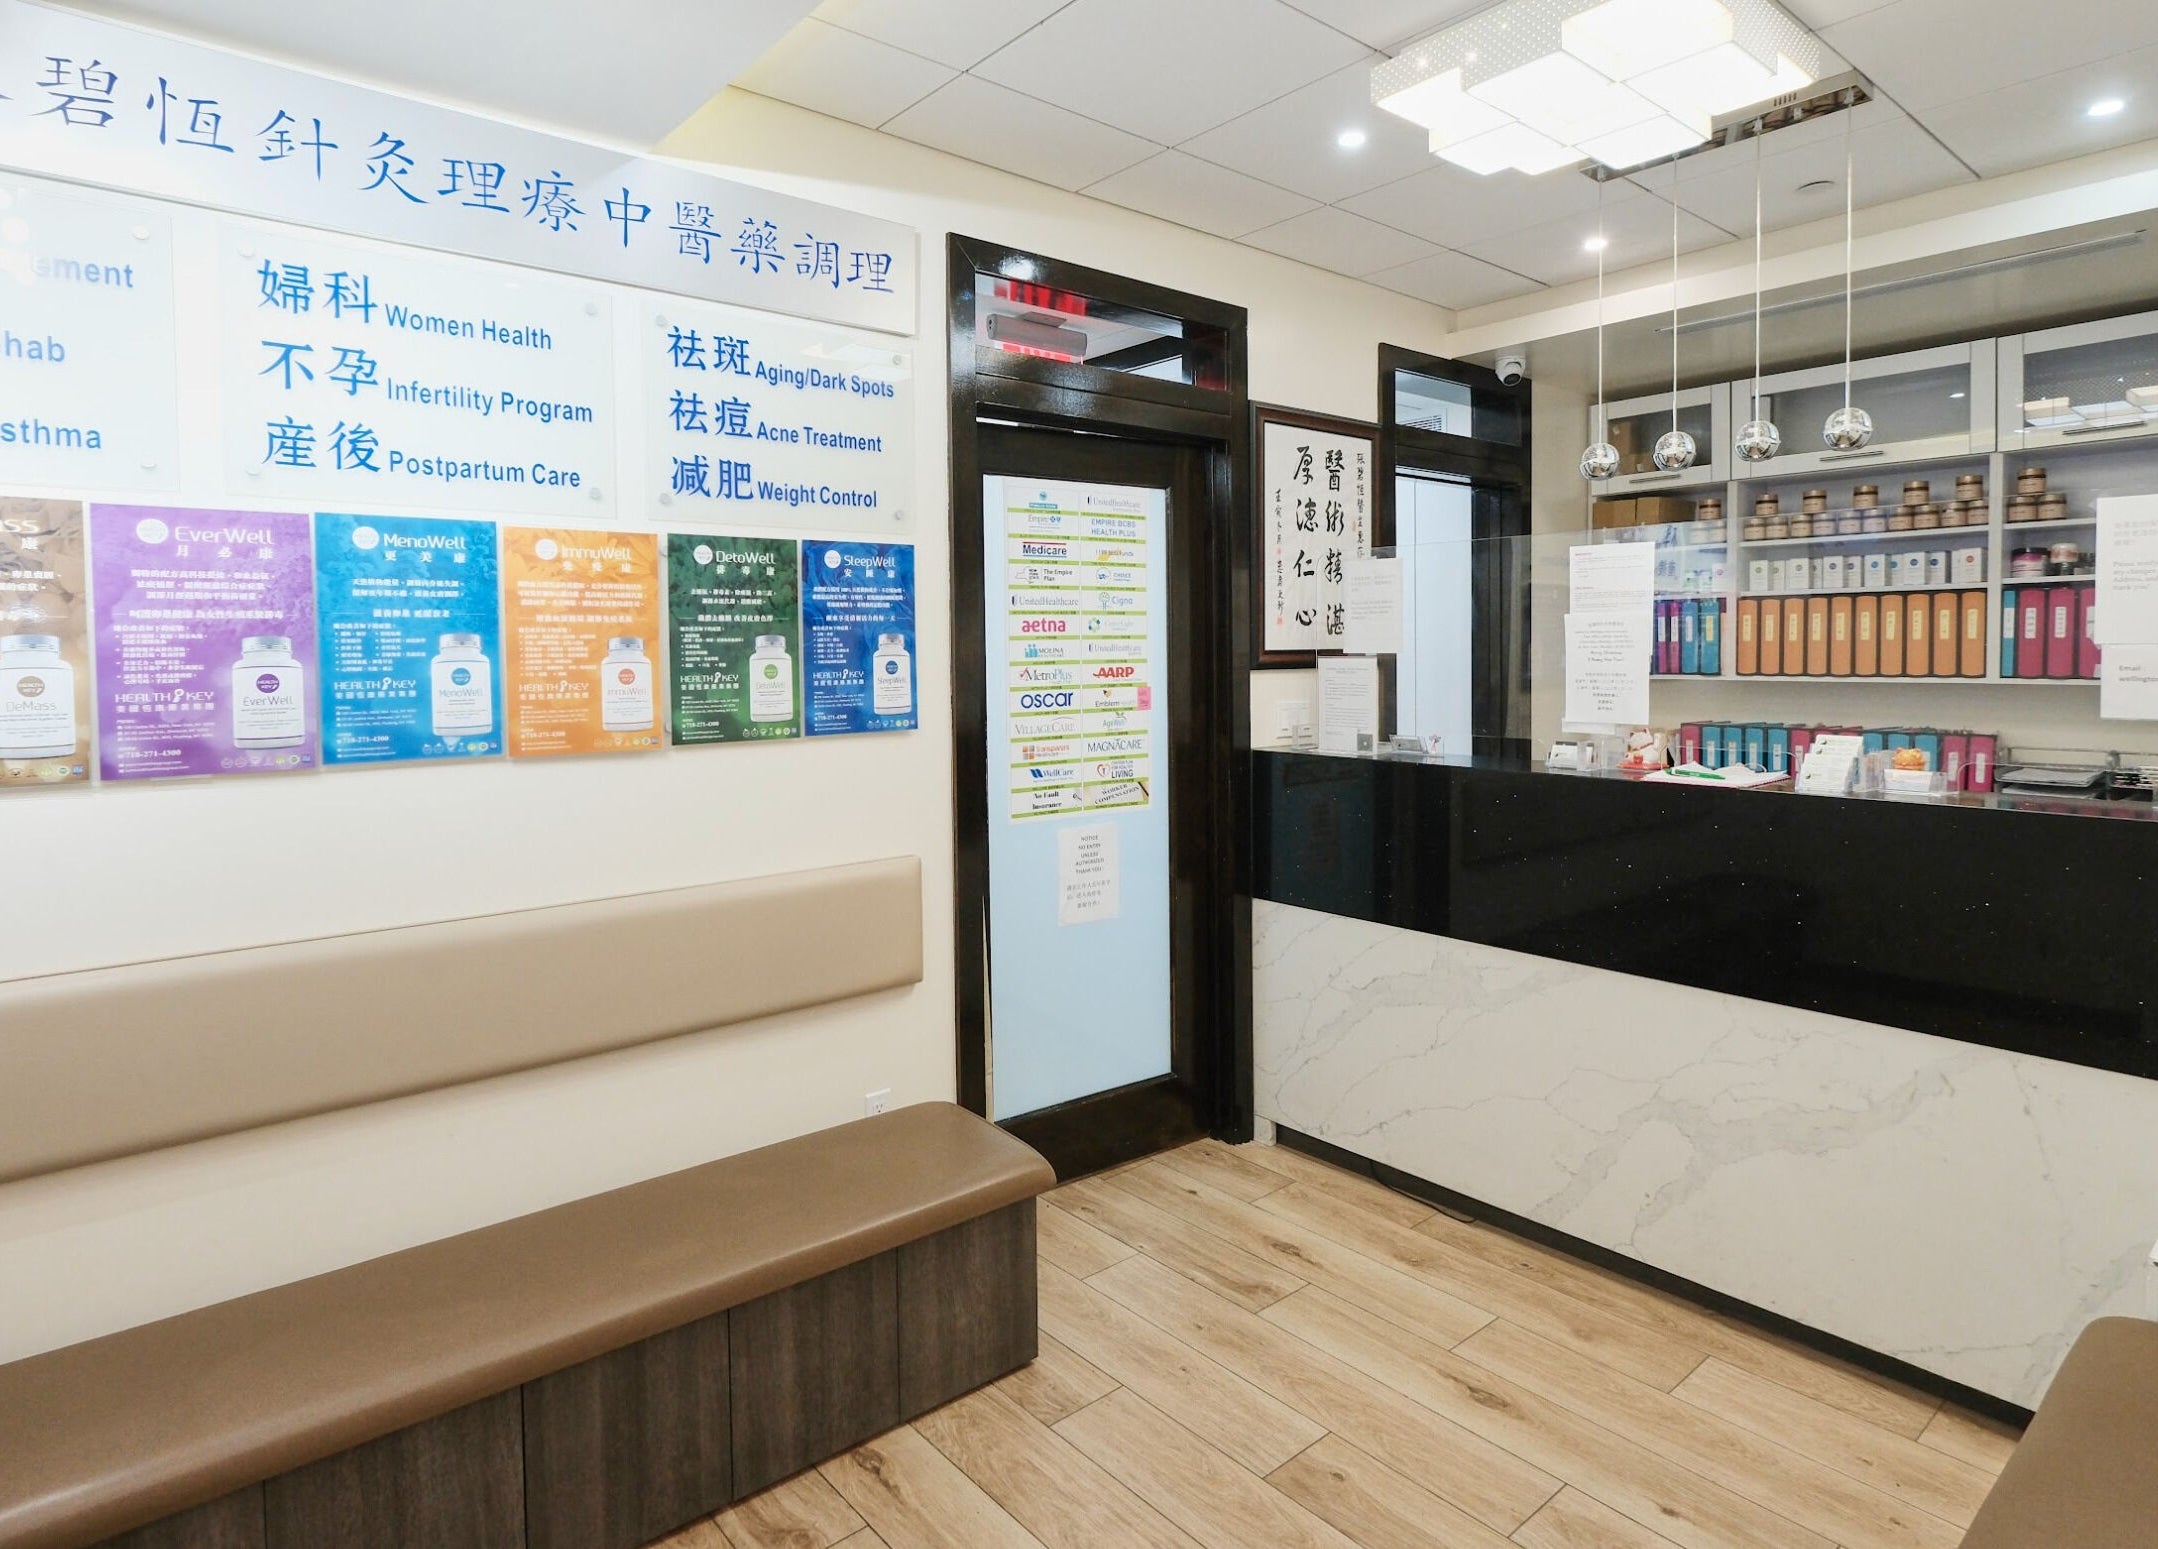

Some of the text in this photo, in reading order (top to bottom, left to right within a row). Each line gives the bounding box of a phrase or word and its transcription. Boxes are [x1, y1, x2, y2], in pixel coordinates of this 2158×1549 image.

[0, 56, 893, 293] 碧恆針灸理療中醫藥調理
[257, 259, 378, 323] 婦科
[385, 303, 551, 349] Women Health
[667, 326, 751, 376] 祛斑
[258, 340, 378, 395] 不孕
[755, 361, 894, 398] Aging/Dark Spots
[388, 378, 593, 422] Infertility Program
[669, 389, 753, 438] 祛痘
[757, 421, 882, 452] Acne Treatment
[390, 450, 581, 488] Postpartum Care
[758, 481, 877, 508] Weight Control
[175, 526, 275, 545] EverWell
[1091, 528, 1136, 537] HEALTH PLUS
[383, 534, 466, 549] MenoWell
[562, 544, 632, 561] ImmuWell
[715, 550, 776, 565] DetoWell
[1022, 544, 1067, 556] Medicare
[843, 555, 896, 568] SleepWell
[1019, 595, 1079, 606] UnitedHealthcare
[1021, 617, 1066, 633] aetna
[680, 673, 739, 683] HEALTH KEY
[812, 671, 841, 679] HEALTH
[1025, 667, 1073, 682] MetroPlus
[1096, 666, 1135, 678] AARP
[334, 679, 416, 690] HEALTH KEY
[115, 692, 214, 703] HEALTH KEY
[1020, 692, 1074, 709] oscar
[1111, 769, 1134, 779] LIVING
